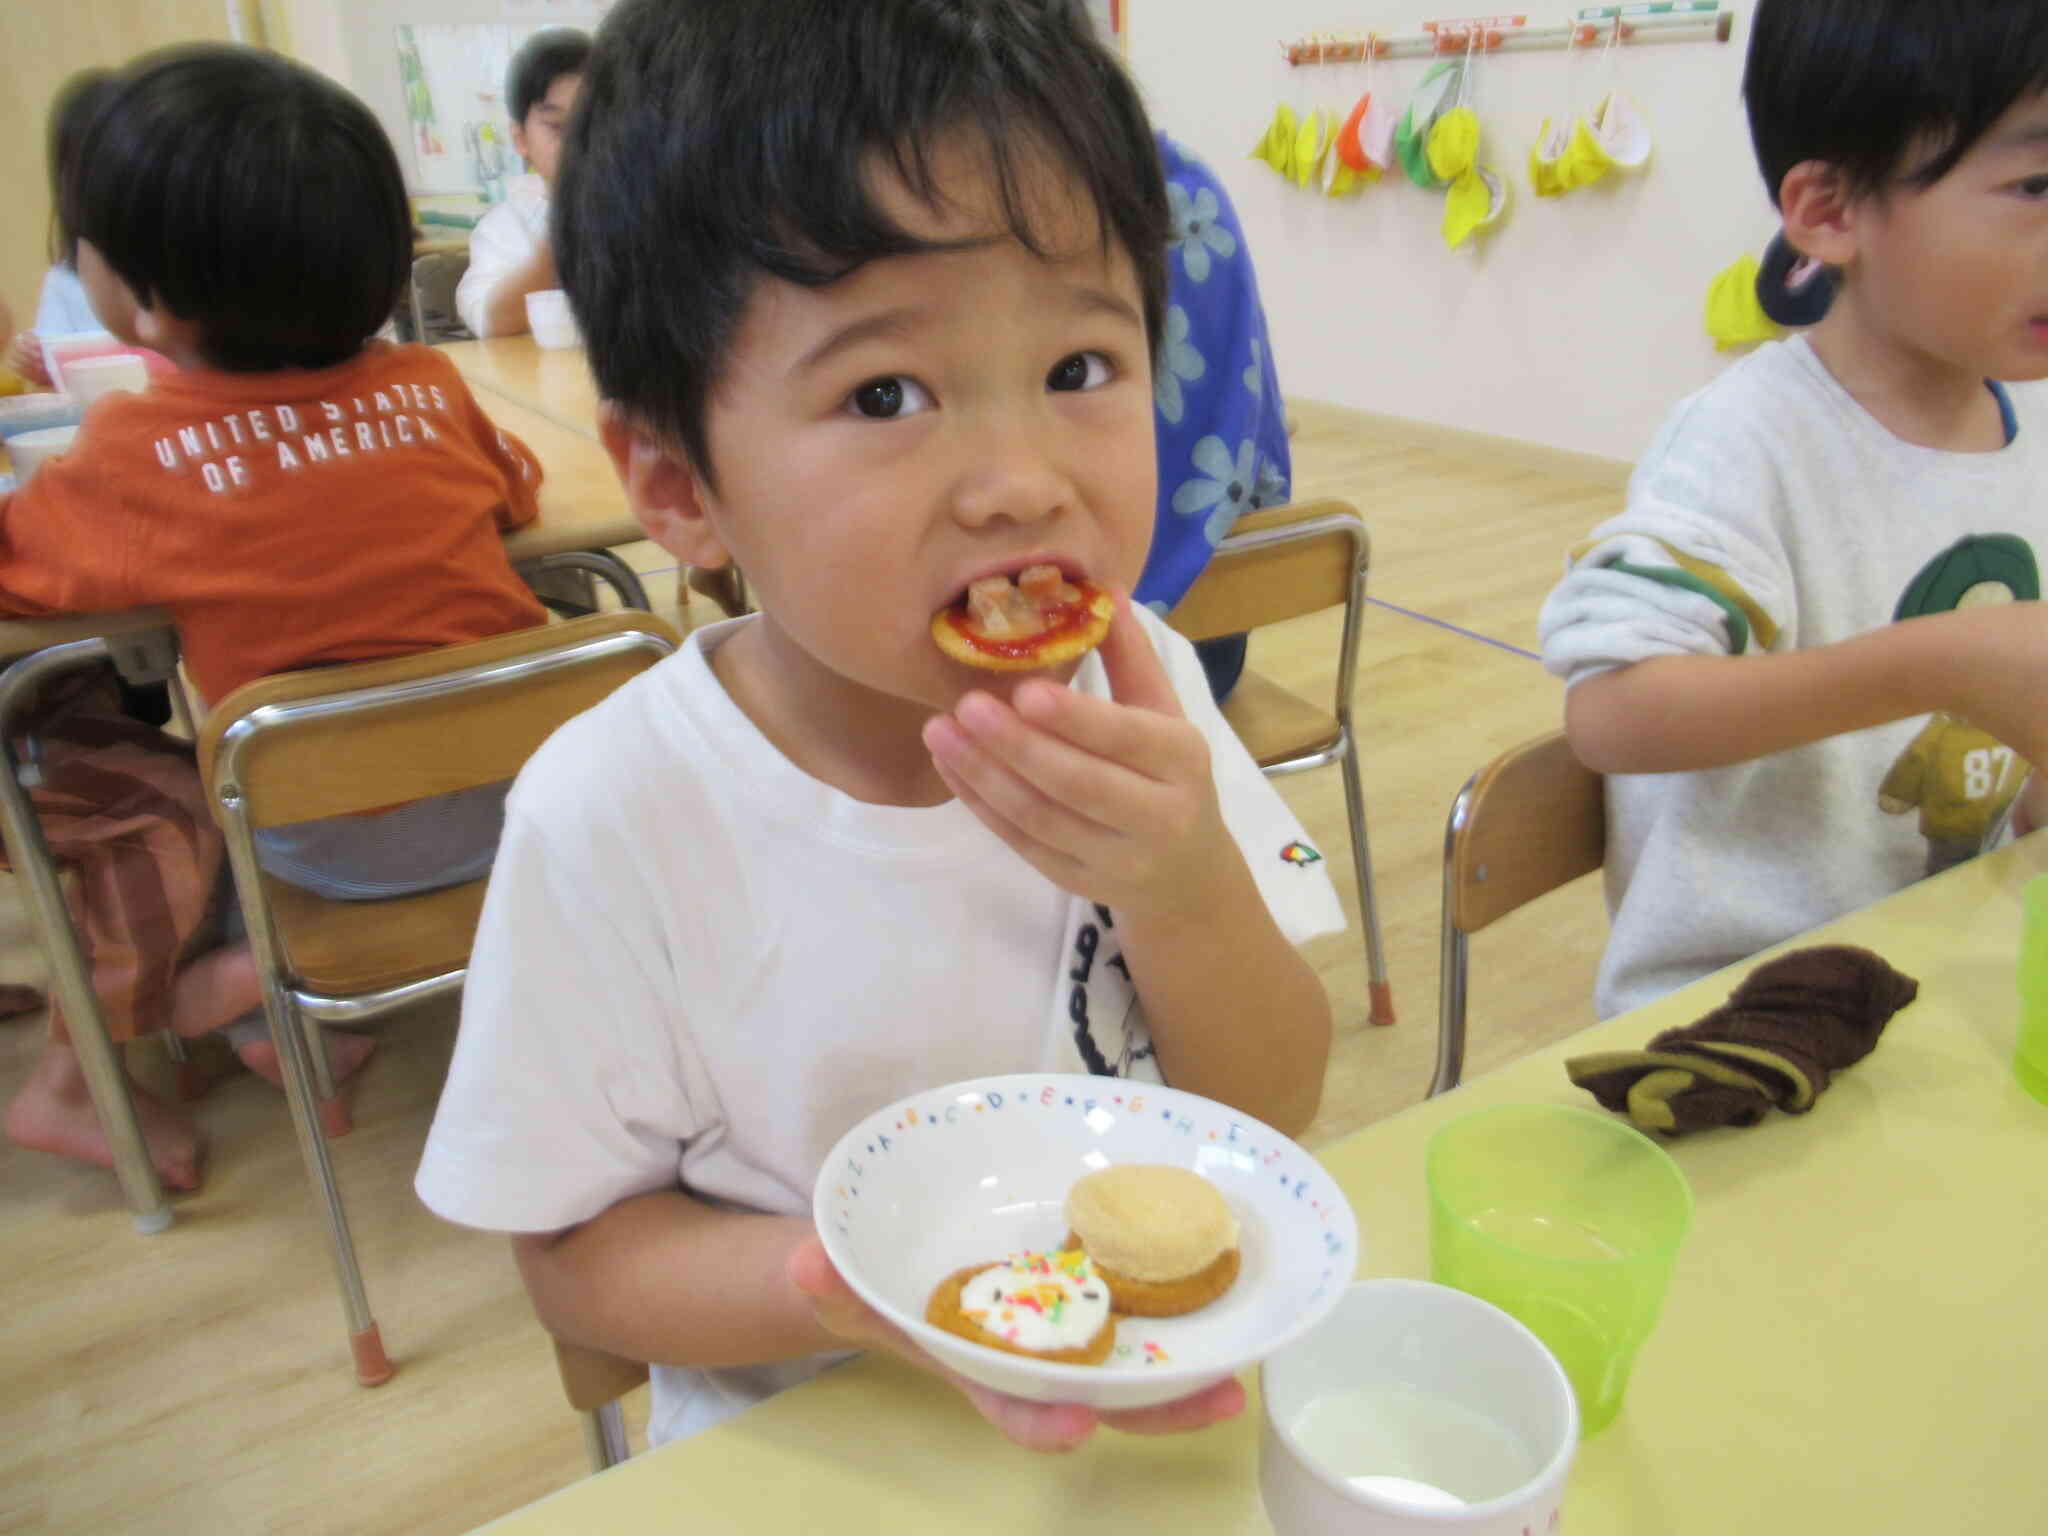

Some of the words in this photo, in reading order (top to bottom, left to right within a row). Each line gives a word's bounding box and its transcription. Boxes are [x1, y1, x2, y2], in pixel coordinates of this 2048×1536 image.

[154, 404, 299, 469] UNITED
[201, 455, 249, 493] OF
[276, 414, 438, 470] AMERICA
[1963, 744, 2016, 800] 87
